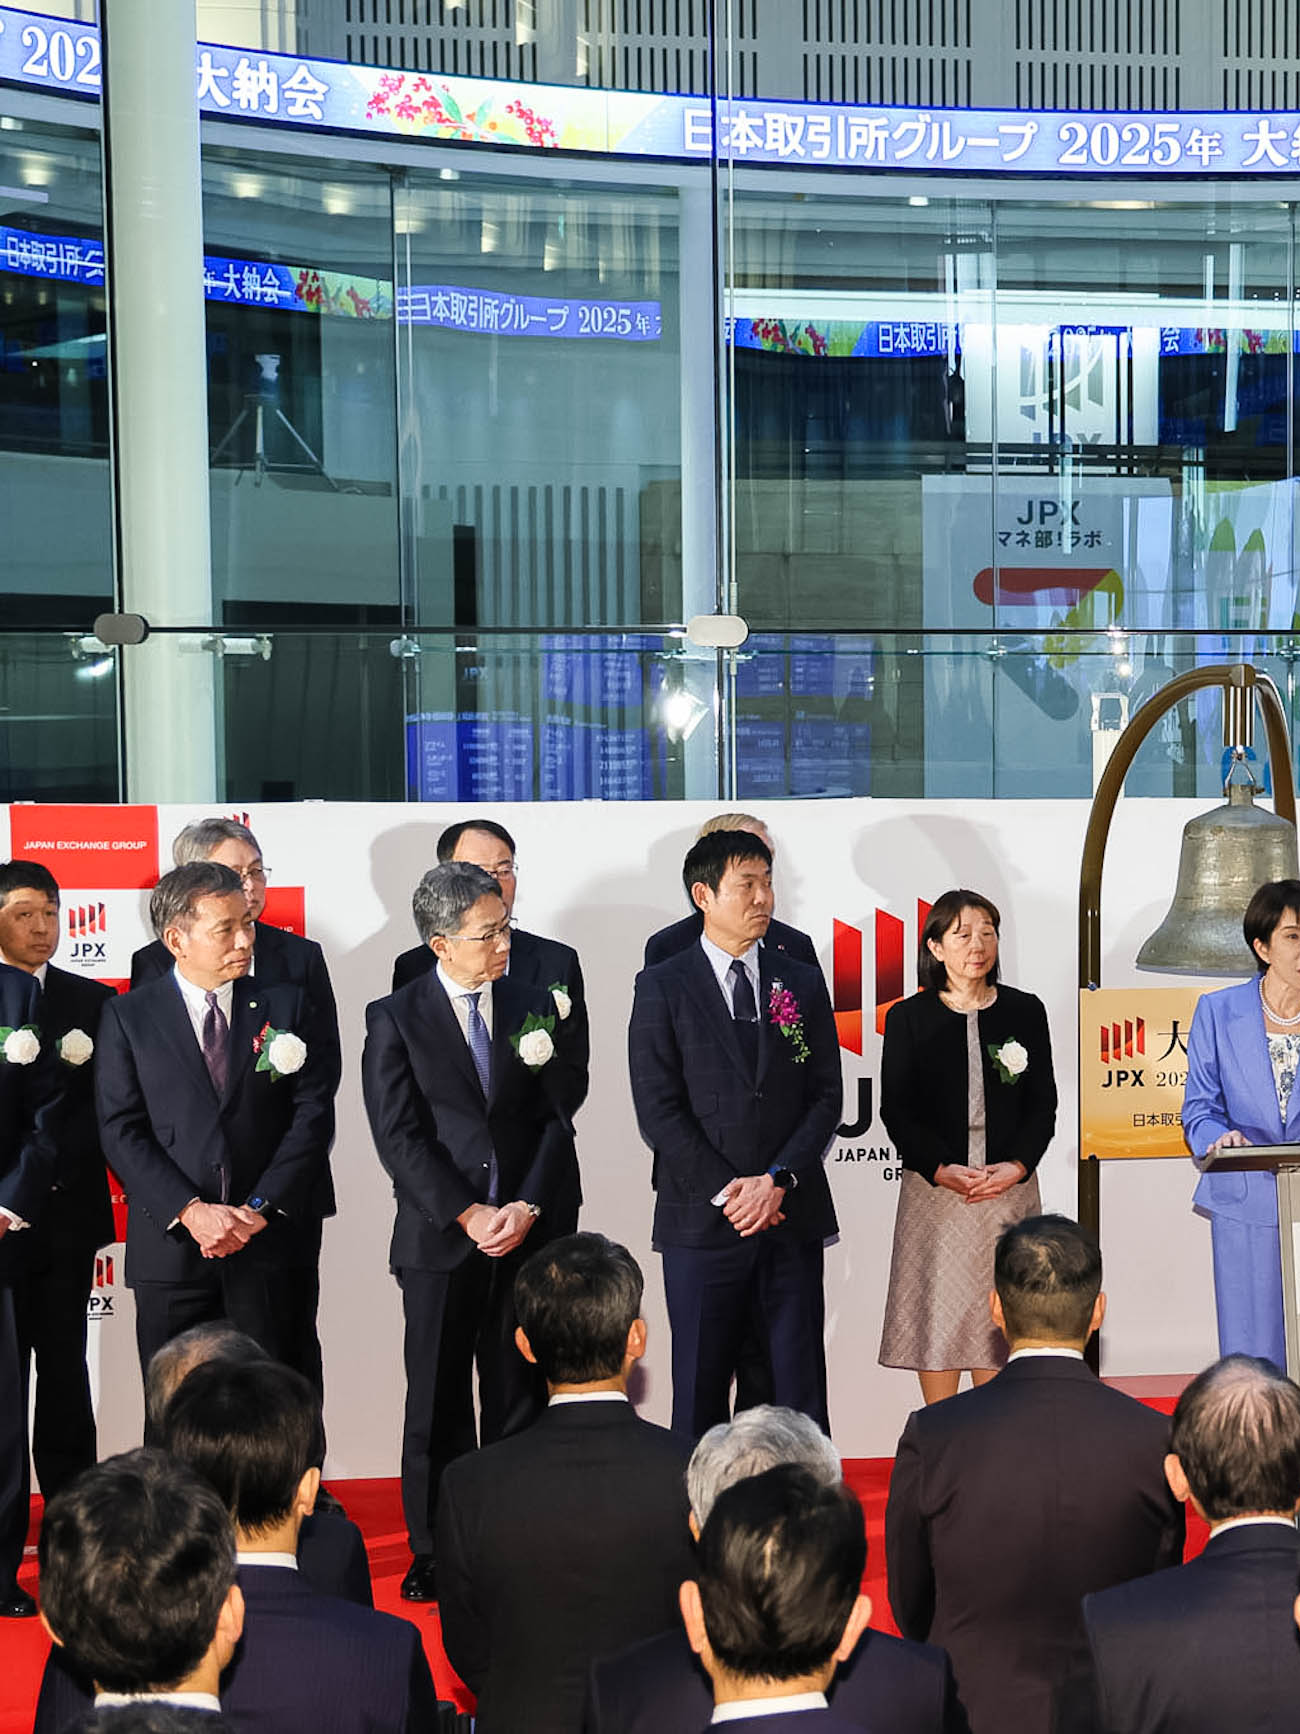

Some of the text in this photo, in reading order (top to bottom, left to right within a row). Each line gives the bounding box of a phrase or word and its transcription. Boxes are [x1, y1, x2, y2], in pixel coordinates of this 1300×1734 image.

[684, 109, 1038, 161] 日本取引所グループ
[1057, 122, 1224, 166] 2025年
[578, 306, 649, 336] 2025年
[1016, 500, 1080, 525] JPX
[24, 841, 147, 850] JAPAN EXCHANGE GROUP
[71, 943, 106, 957] JPX
[1102, 1070, 1145, 1087] JPX
[835, 1148, 890, 1161] JAPAN
[90, 1297, 113, 1310] PX
